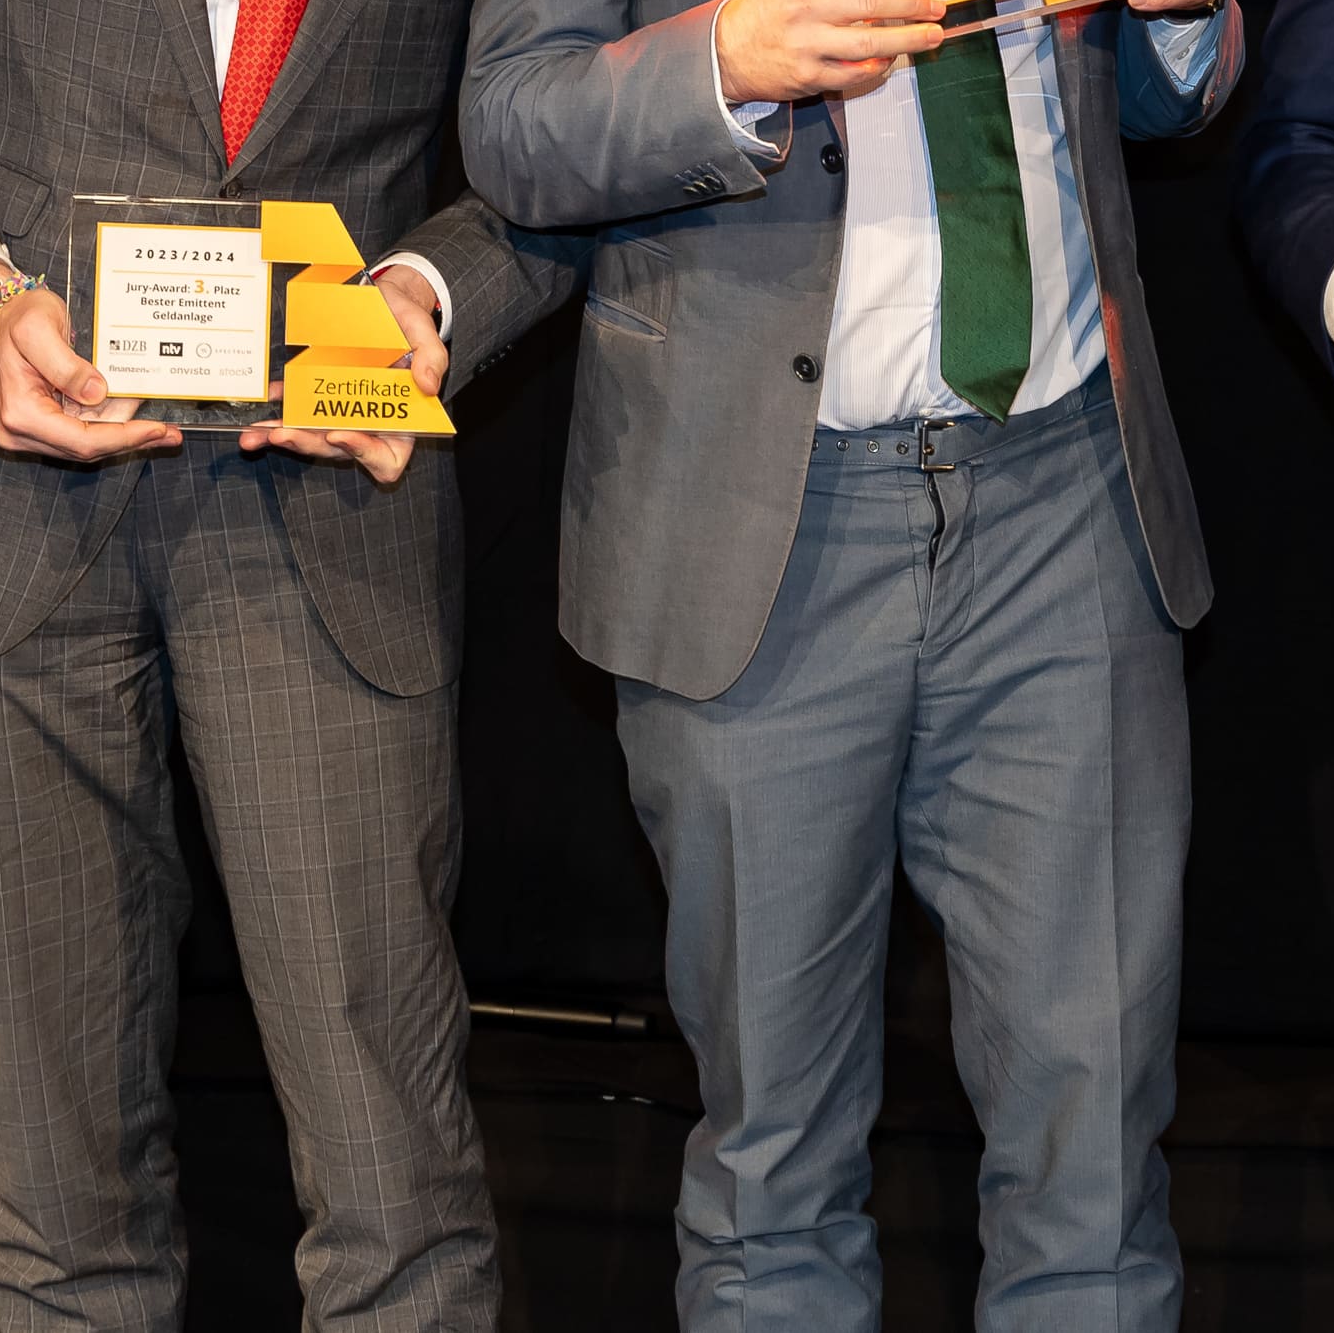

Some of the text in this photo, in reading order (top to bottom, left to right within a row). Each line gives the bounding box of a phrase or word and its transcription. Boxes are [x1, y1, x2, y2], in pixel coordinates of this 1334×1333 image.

[134, 248, 235, 262] 2023/2024
[126, 281, 191, 294] Jury-Award:
[214, 285, 241, 296] Platz
[140, 297, 226, 309] Bester Emittent
[152, 310, 214, 323] Geldanlage
[122, 340, 147, 353] DZB
[161, 343, 182, 355] ntv
[170, 365, 211, 376] onvista
[313, 377, 411, 397] Zertifikate
[312, 399, 409, 420] AWARDS
